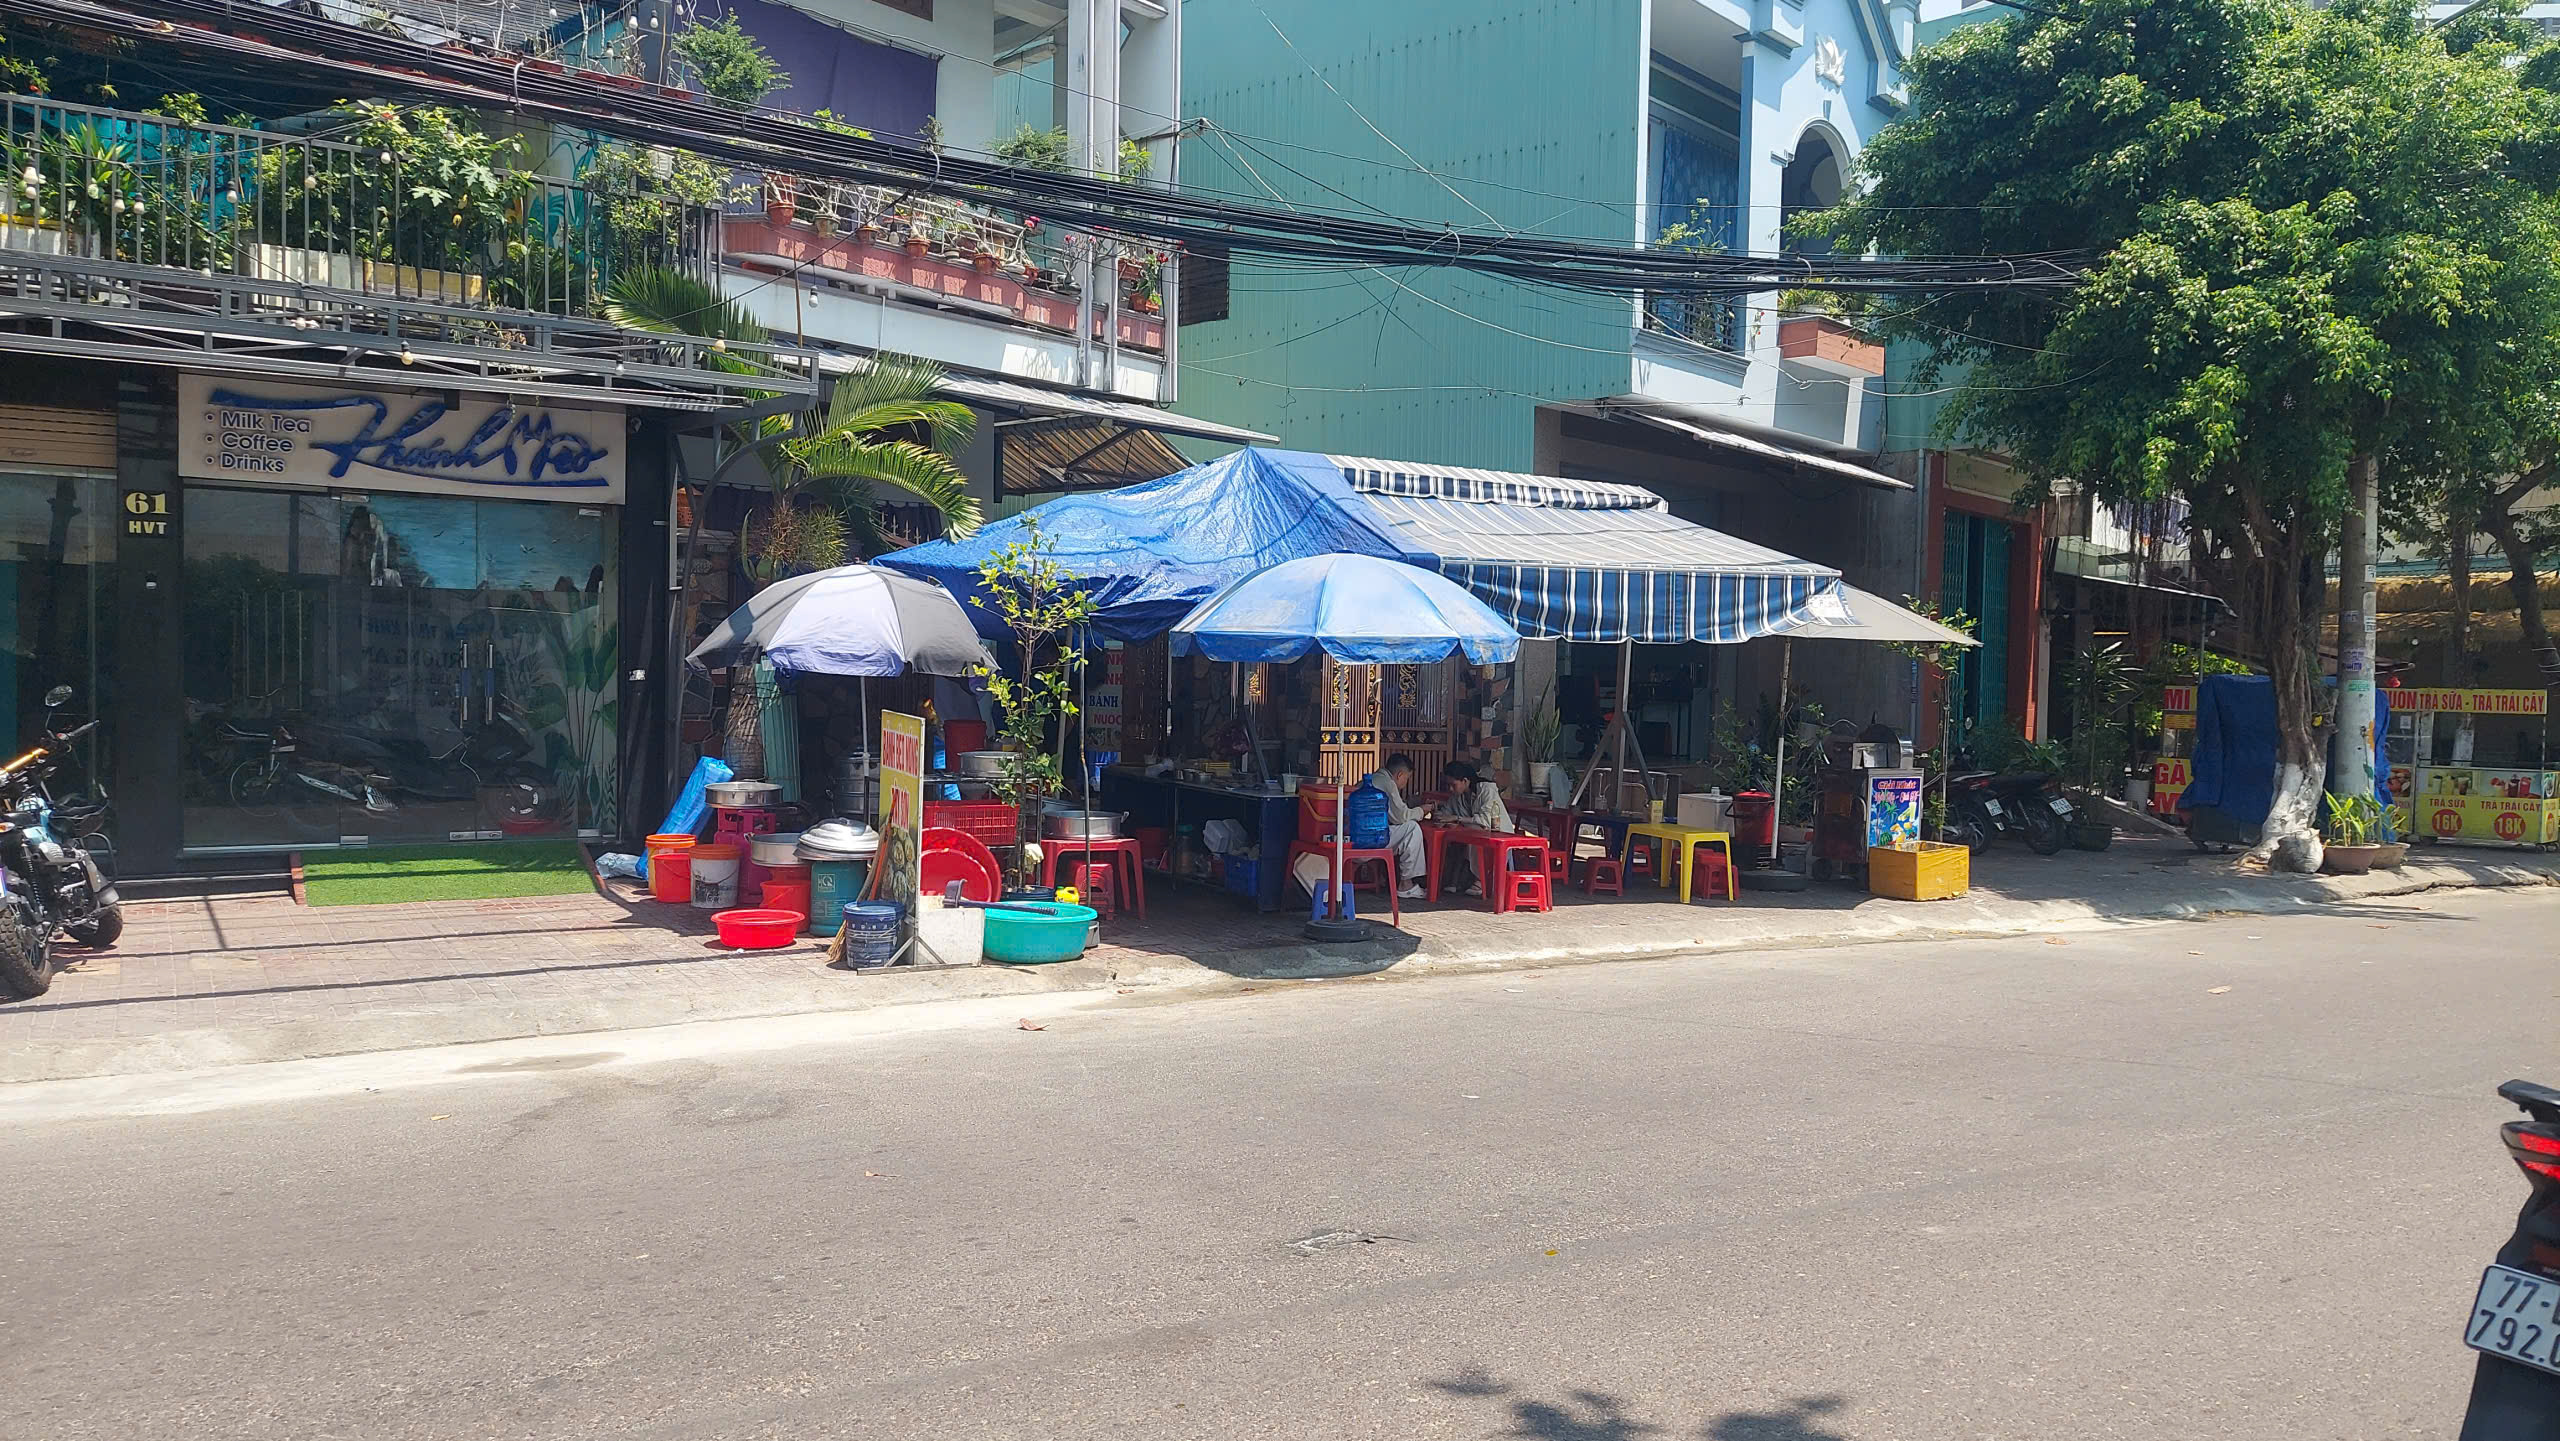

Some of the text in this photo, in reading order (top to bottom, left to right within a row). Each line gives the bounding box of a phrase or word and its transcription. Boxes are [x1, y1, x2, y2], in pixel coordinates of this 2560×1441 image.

[221, 410, 311, 433] Milk Tea
[221, 432, 293, 452] Coffee
[221, 453, 284, 472] Drinks
[126, 492, 172, 514] 61
[128, 520, 167, 535] HVT
[2155, 760, 2187, 785] GÀ
[2435, 814, 2460, 831] 16K
[2497, 817, 2522, 834] 18K
